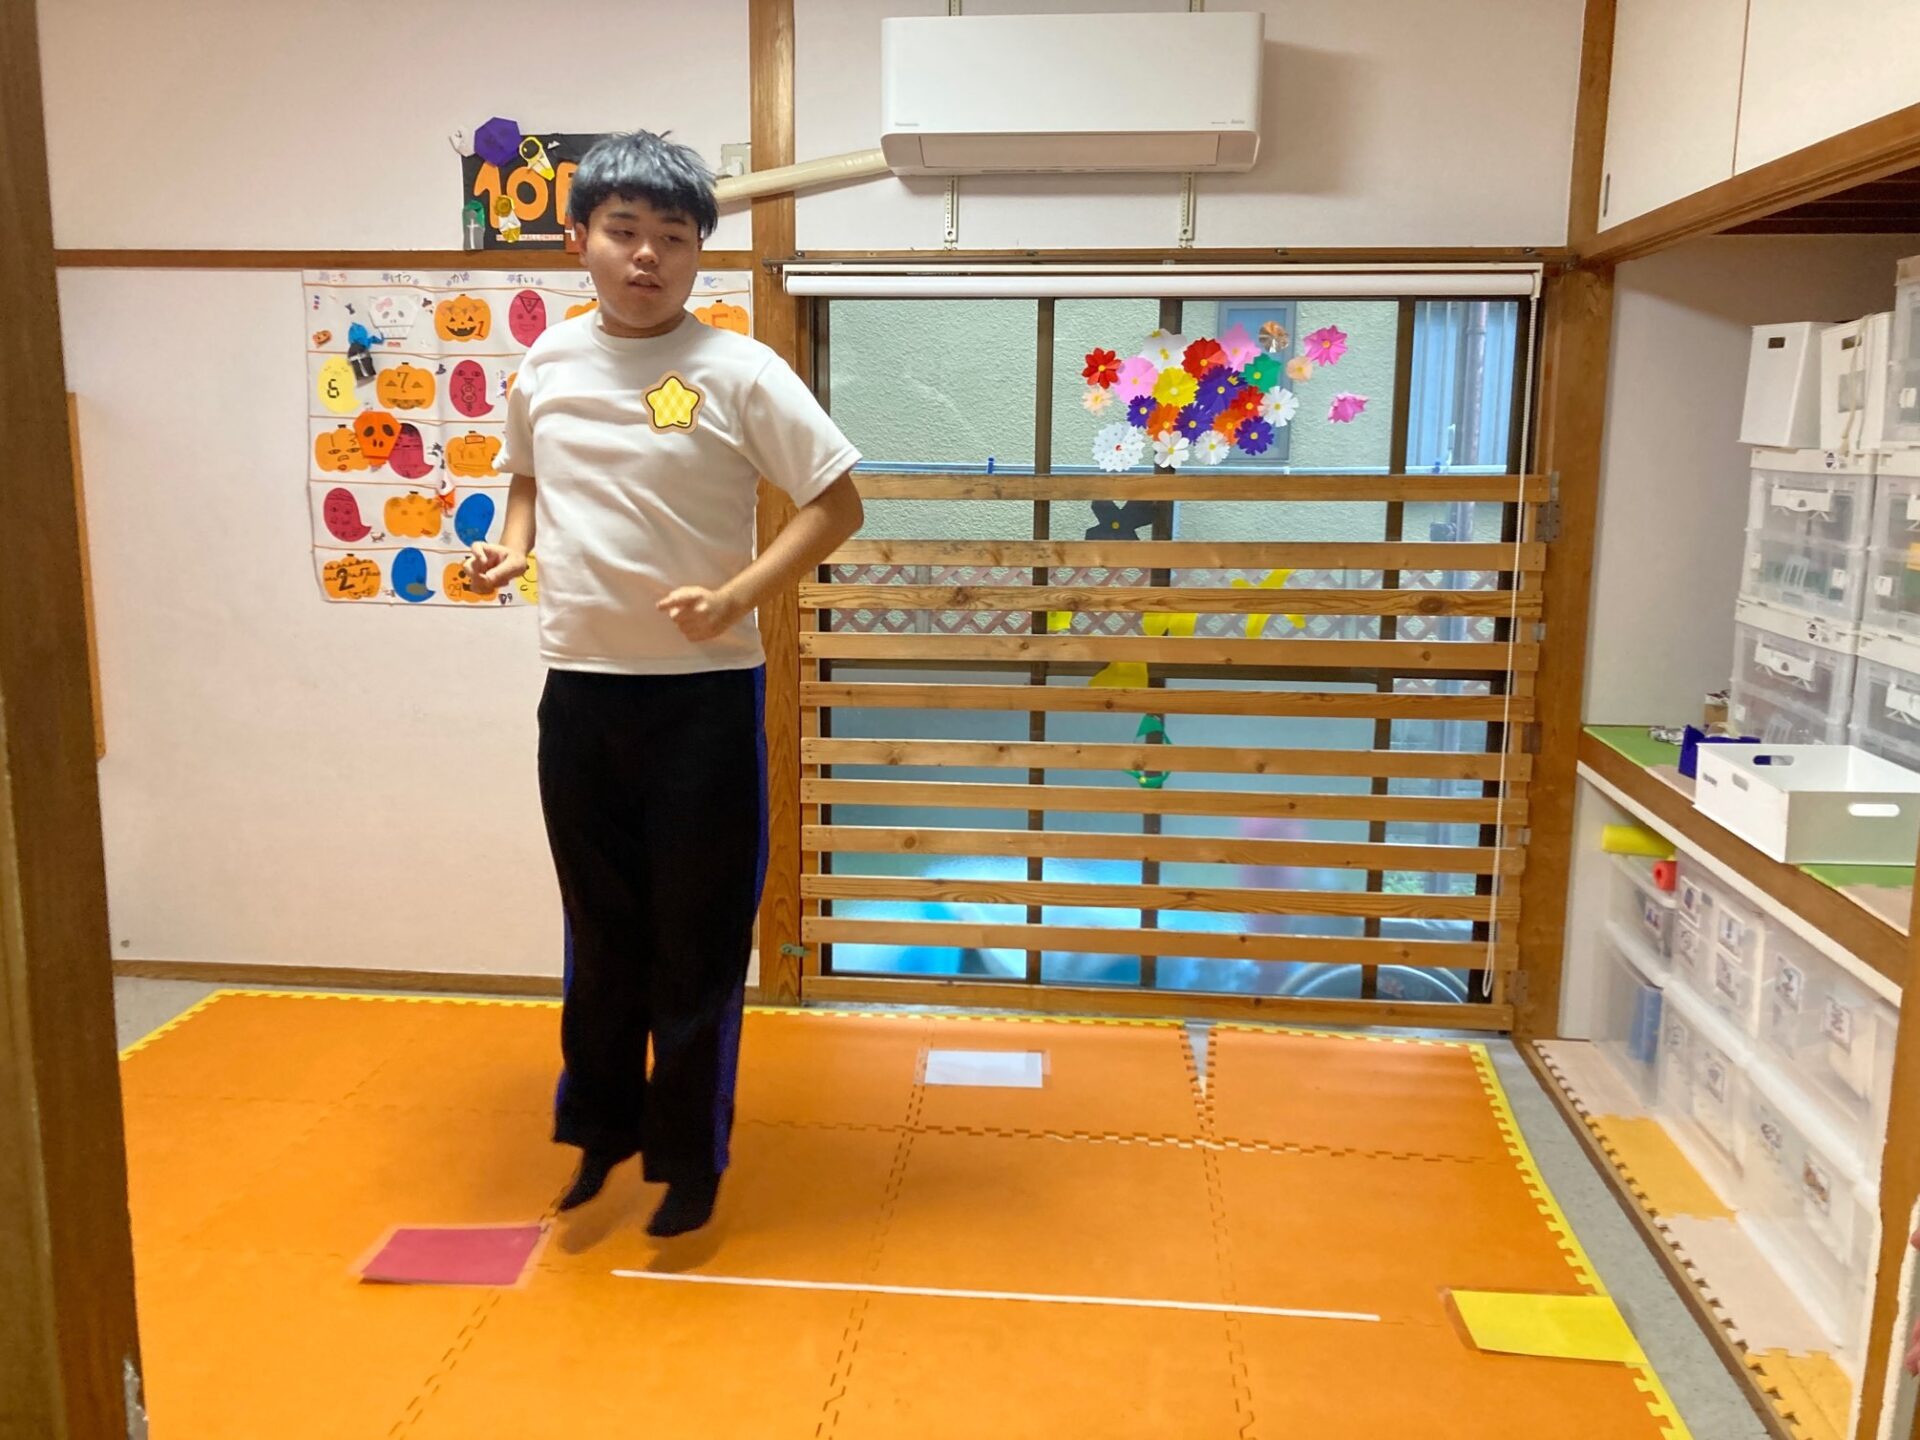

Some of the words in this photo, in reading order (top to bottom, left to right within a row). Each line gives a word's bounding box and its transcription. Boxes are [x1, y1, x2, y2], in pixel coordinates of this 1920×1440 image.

[327, 378, 340, 399] 6
[397, 371, 410, 389] 7
[336, 567, 370, 592] 27
